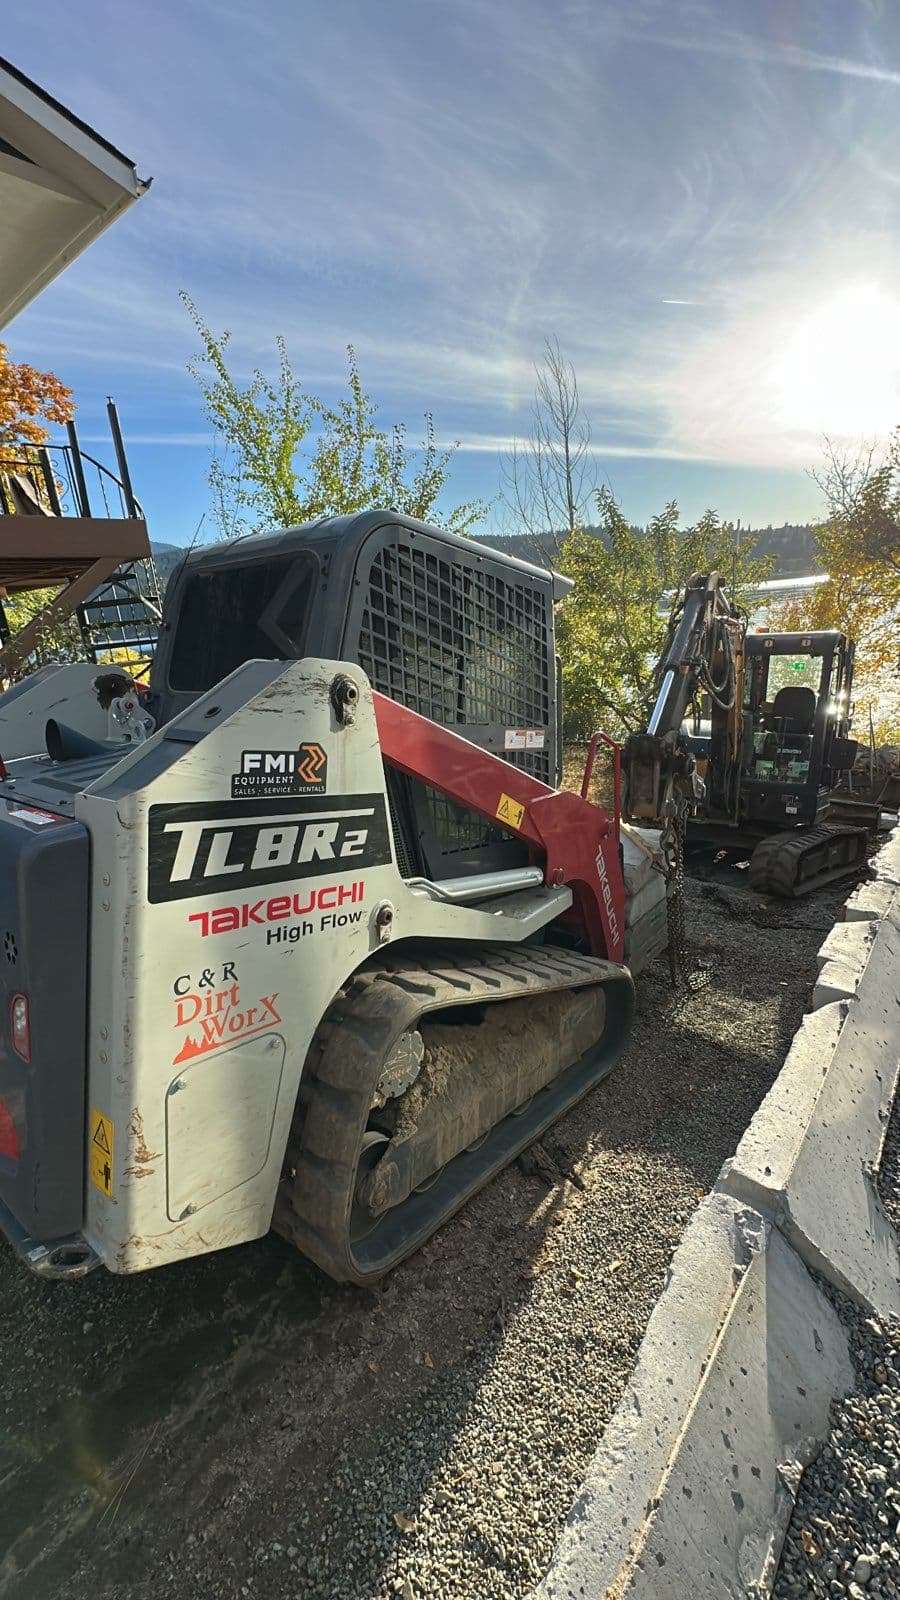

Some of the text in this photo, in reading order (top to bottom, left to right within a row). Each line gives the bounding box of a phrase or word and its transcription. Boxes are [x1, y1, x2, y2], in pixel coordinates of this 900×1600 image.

[234, 776, 295, 786] EQUIPMENT
[244, 754, 295, 774] FMI
[234, 785, 325, 795] SALES SERVICE RENTALS
[163, 807, 375, 883] TL8R2
[266, 910, 363, 945] High Flow
[173, 961, 239, 996] C & R
[174, 982, 240, 1028] Dirt
